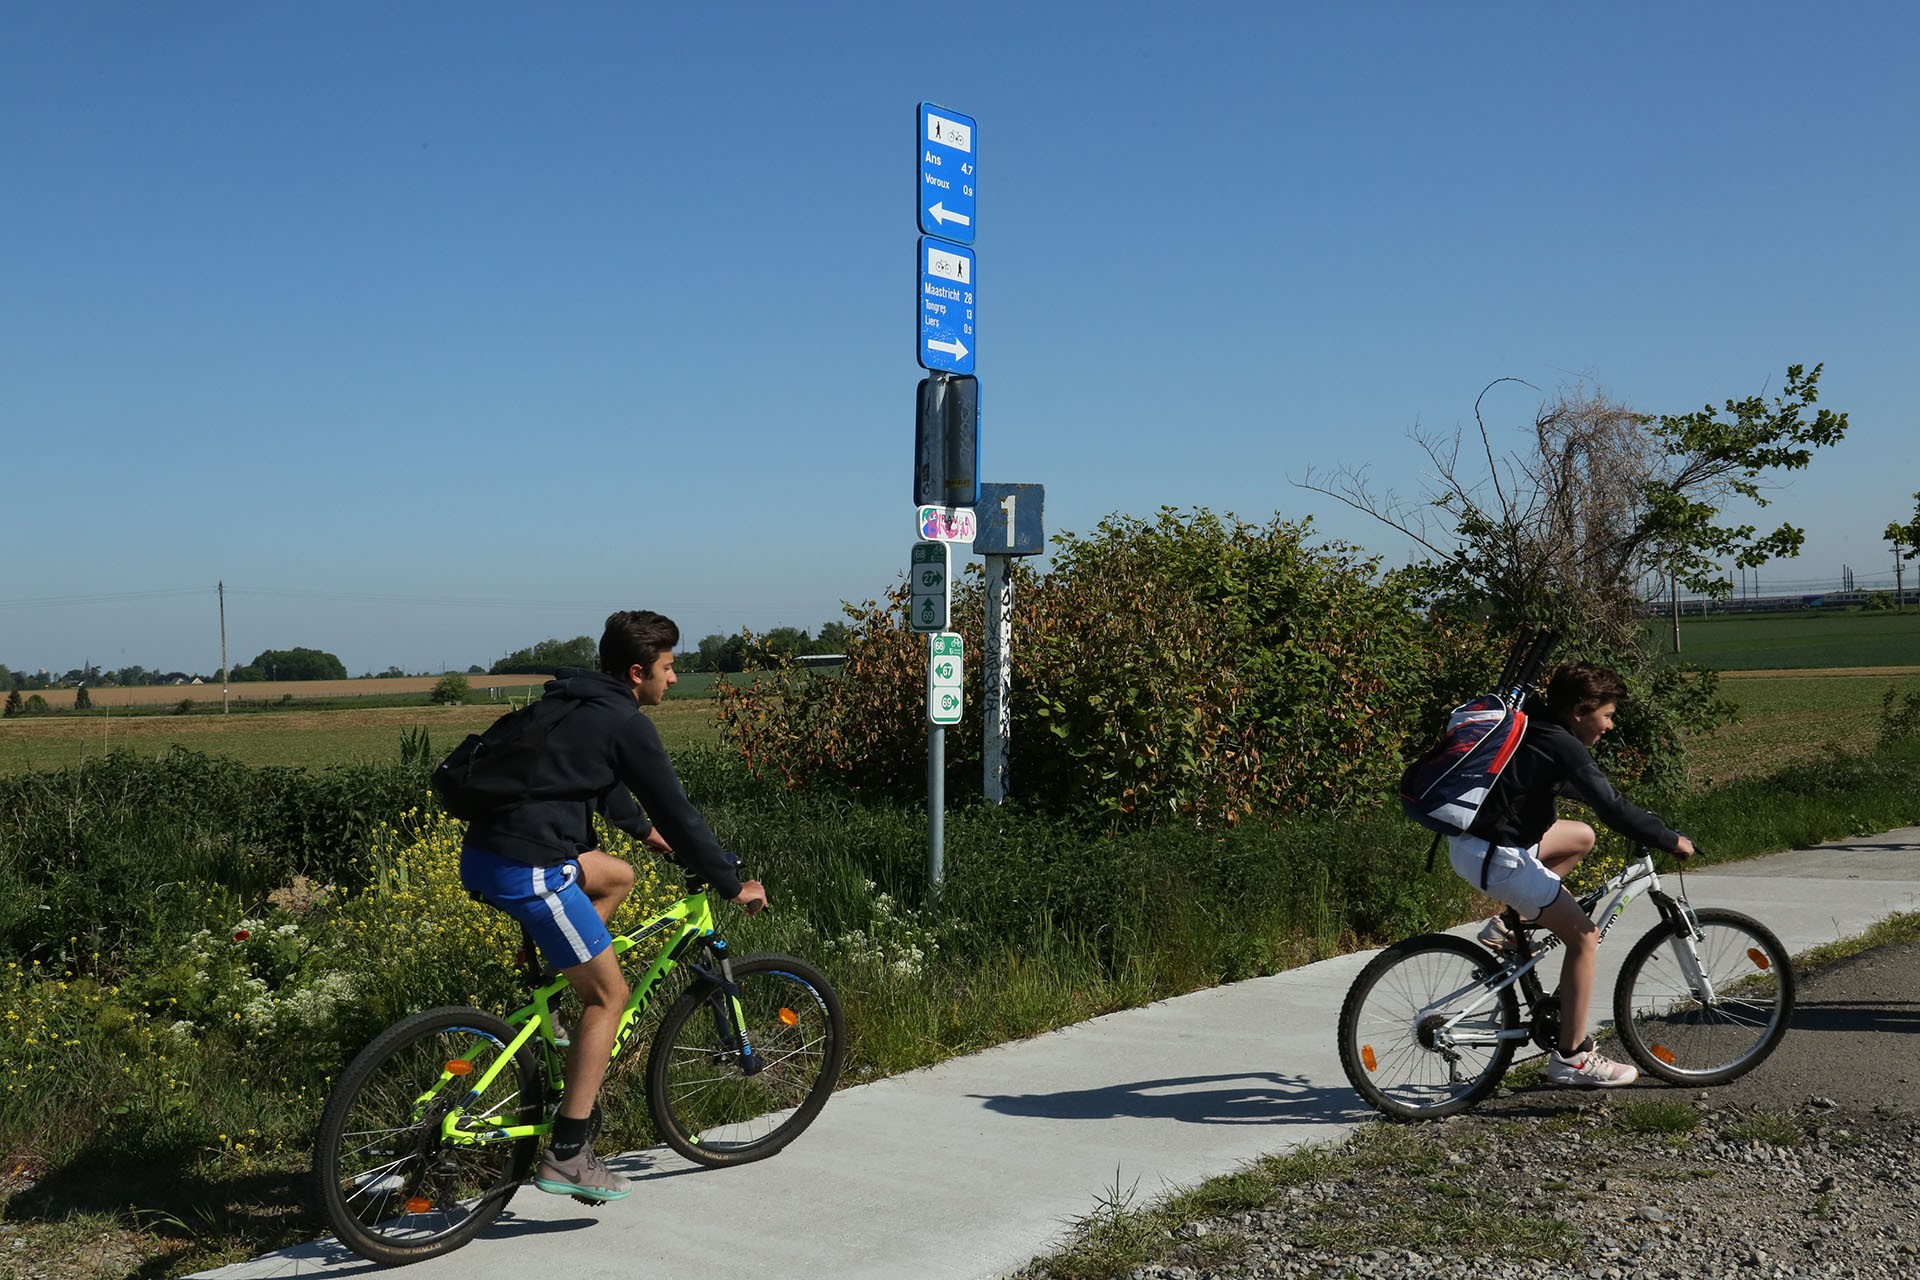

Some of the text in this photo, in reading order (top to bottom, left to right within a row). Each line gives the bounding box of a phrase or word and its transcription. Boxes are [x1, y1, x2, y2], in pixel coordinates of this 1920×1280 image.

[925, 151, 942, 166] Ans
[925, 172, 950, 190] Voroux
[925, 282, 972, 305] Maastricht 28
[925, 299, 972, 320] Tongres 13
[925, 315, 939, 328] Liers
[1000, 495, 1016, 548] 1
[915, 549, 925, 559] 68
[923, 573, 934, 584] 27
[923, 609, 933, 622] 69
[935, 641, 944, 651] 68
[942, 665, 953, 676] 67
[942, 697, 952, 708] 69
